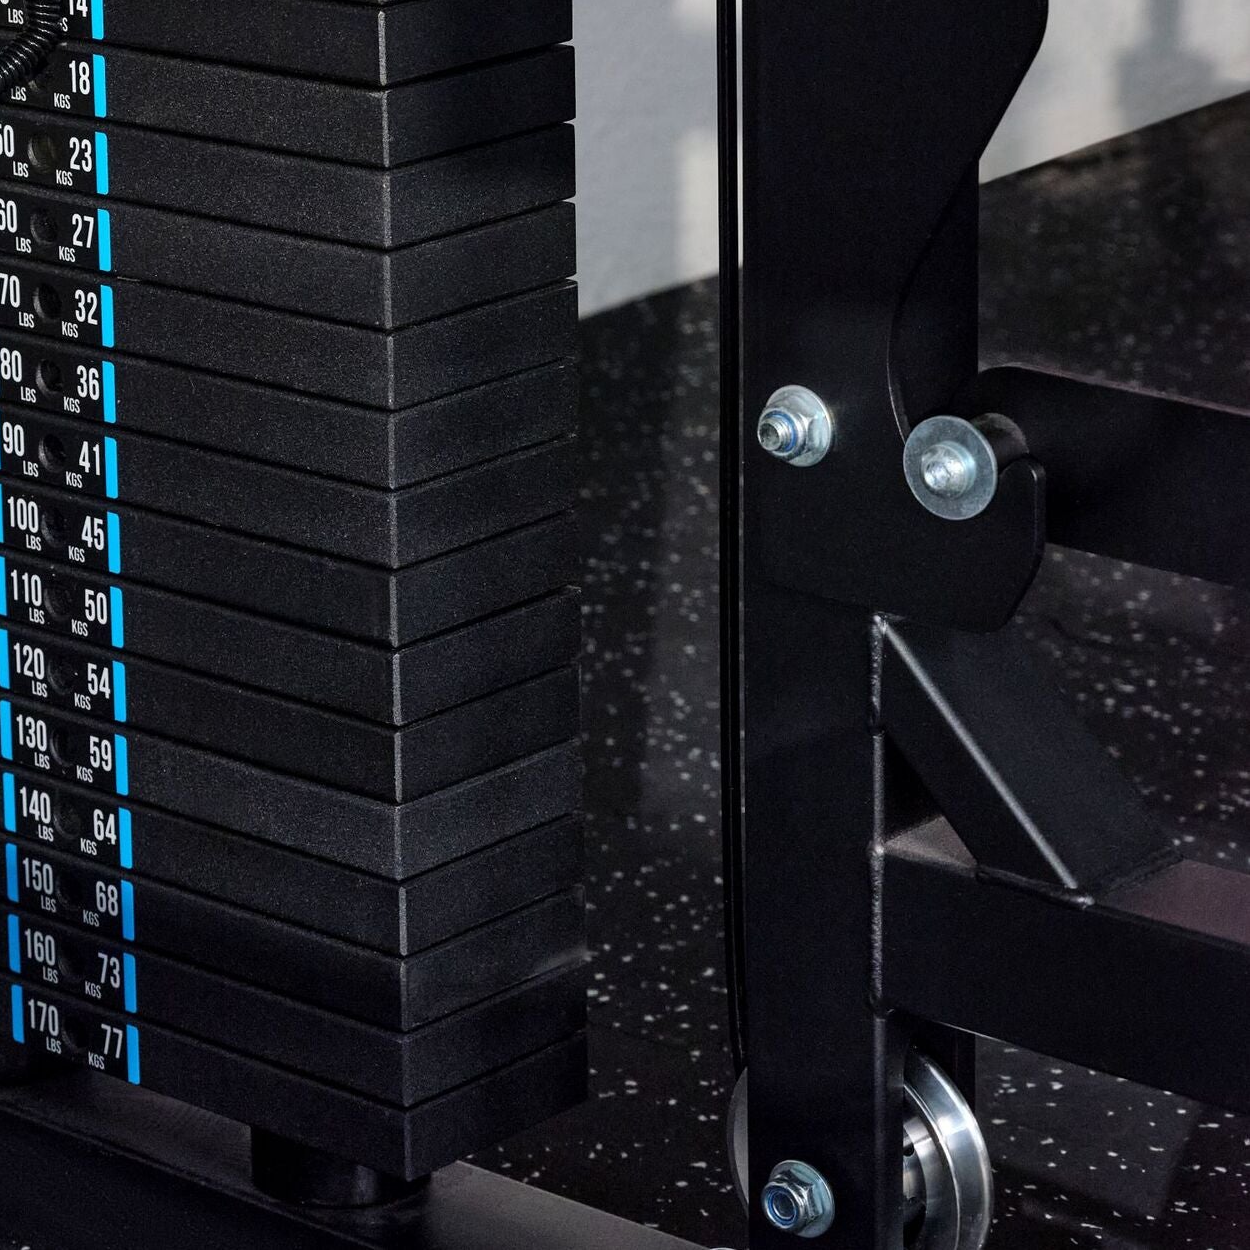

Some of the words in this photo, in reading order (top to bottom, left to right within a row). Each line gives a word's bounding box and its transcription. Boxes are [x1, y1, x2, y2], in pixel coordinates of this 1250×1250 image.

[8, 9, 23, 24] LBS
[69, 61, 90, 94] 18
[11, 86, 26, 101] LBS
[54, 94, 70, 109] KGS
[70, 137, 92, 172] 23
[13, 161, 28, 177] LBS
[56, 170, 73, 186] KGS
[72, 214, 94, 248] 27
[16, 237, 31, 253] LBS
[59, 246, 75, 262] KGS
[75, 290, 98, 325] 32
[19, 312, 34, 328] LBS
[62, 322, 78, 338] KGS
[0, 348, 22, 382] 80
[77, 365, 99, 400] 36
[21, 387, 36, 403] LBS
[64, 397, 80, 413] KGS
[3, 422, 24, 456] 90
[79, 441, 100, 475] 41
[23, 461, 38, 477] LBS
[66, 472, 82, 488] KGS
[8, 497, 38, 533] 100
[82, 516, 104, 549] 45
[26, 535, 41, 551] LBS
[69, 546, 85, 562] KGS
[11, 570, 42, 606] 110
[85, 589, 107, 624] 50
[29, 608, 44, 624] LBS
[72, 620, 88, 636] KGS
[14, 643, 44, 679] 120
[32, 681, 47, 697] LBS
[88, 663, 110, 698] 54
[75, 694, 91, 710] KGS
[17, 715, 47, 751] 130
[35, 753, 50, 769] LBS
[90, 736, 112, 771] 59
[77, 766, 93, 783] KGS
[20, 787, 50, 823] 140
[38, 824, 53, 841] LBS
[93, 809, 116, 845] 64
[81, 838, 97, 855] KGS
[23, 858, 53, 894] 150
[41, 895, 56, 912] LBS
[96, 881, 118, 916] 68
[83, 910, 99, 927] KGS
[25, 929, 55, 965] 160
[43, 967, 58, 983] LBS
[98, 953, 120, 988] 73
[85, 981, 101, 998] KGS
[28, 999, 58, 1036] 170
[46, 1037, 61, 1054] LBS
[101, 1024, 123, 1058] 77
[89, 1052, 104, 1069] KGS
